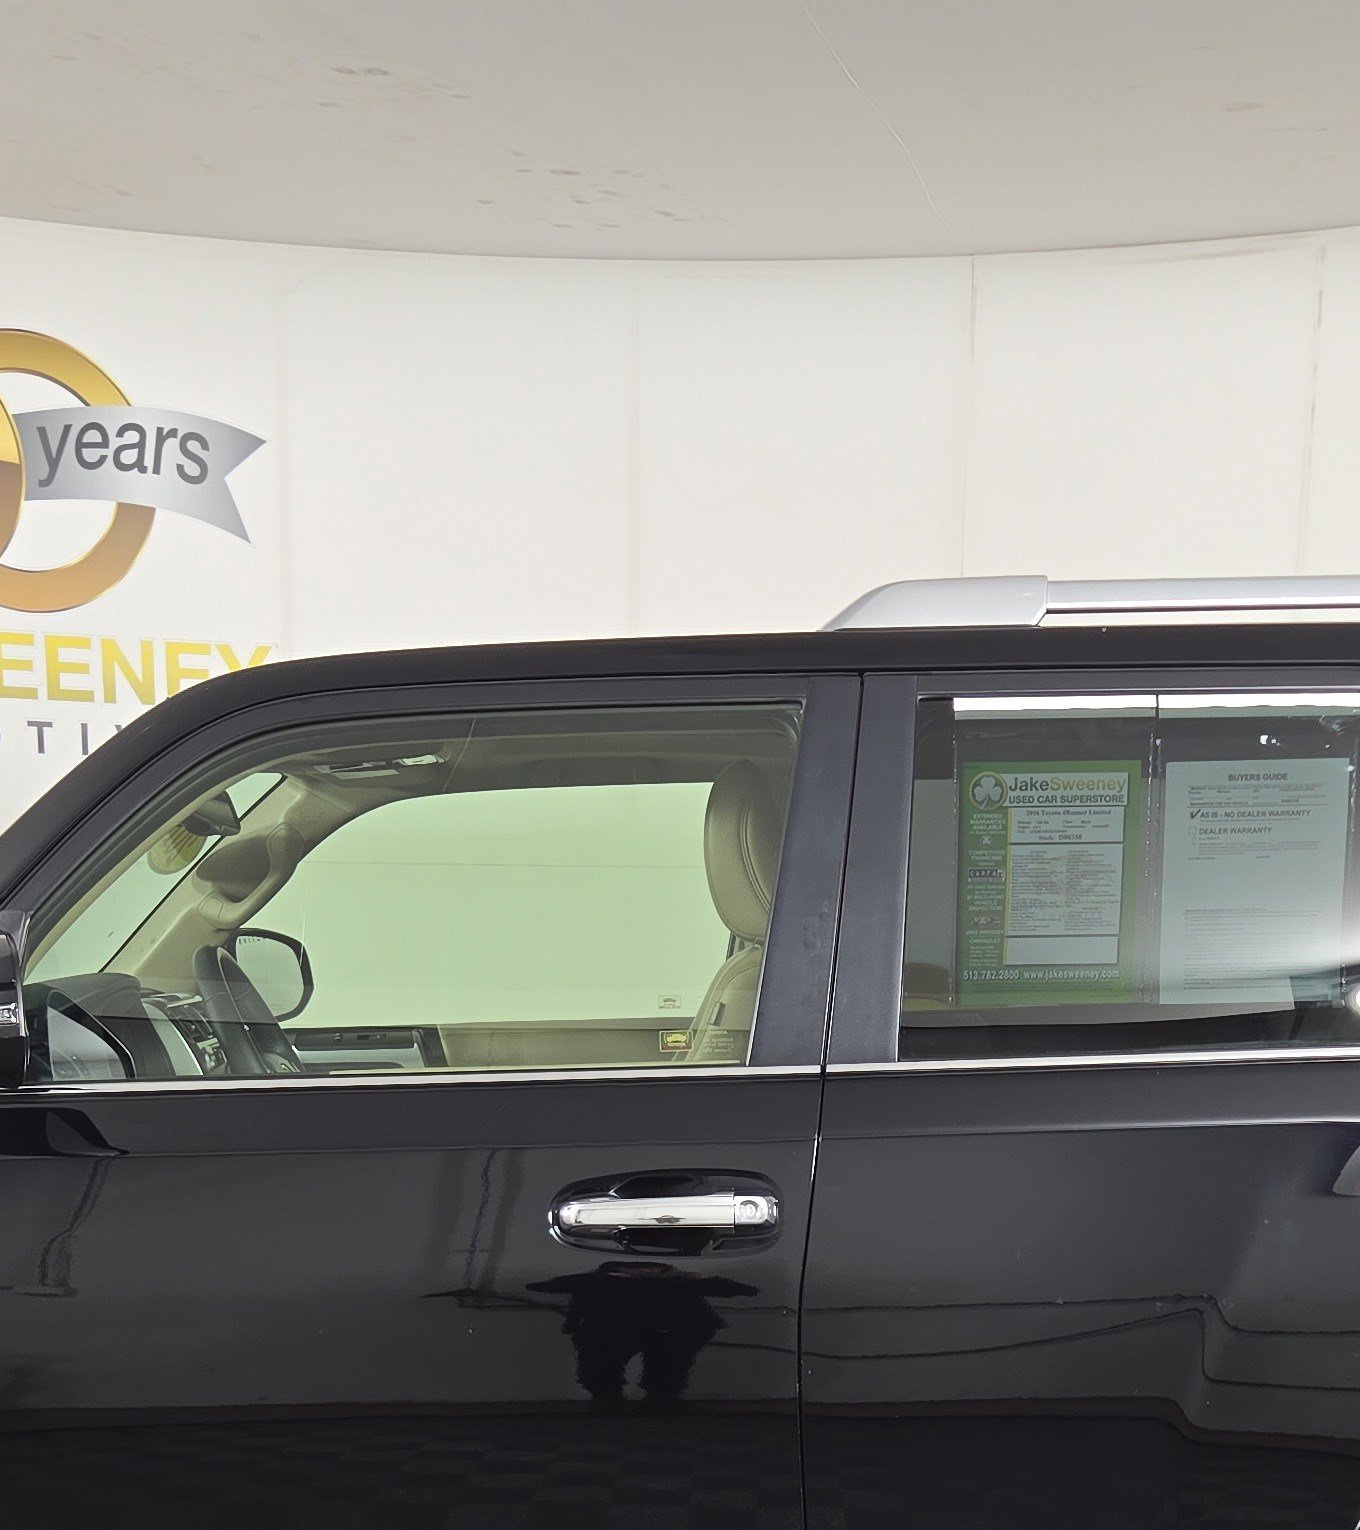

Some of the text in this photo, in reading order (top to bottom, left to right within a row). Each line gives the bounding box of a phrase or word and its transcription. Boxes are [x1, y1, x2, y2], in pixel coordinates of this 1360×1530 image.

[37, 420, 210, 488] years
[1228, 773, 1260, 781] BUYERS
[1009, 794, 1124, 804] USED CAR SUPERSTORE
